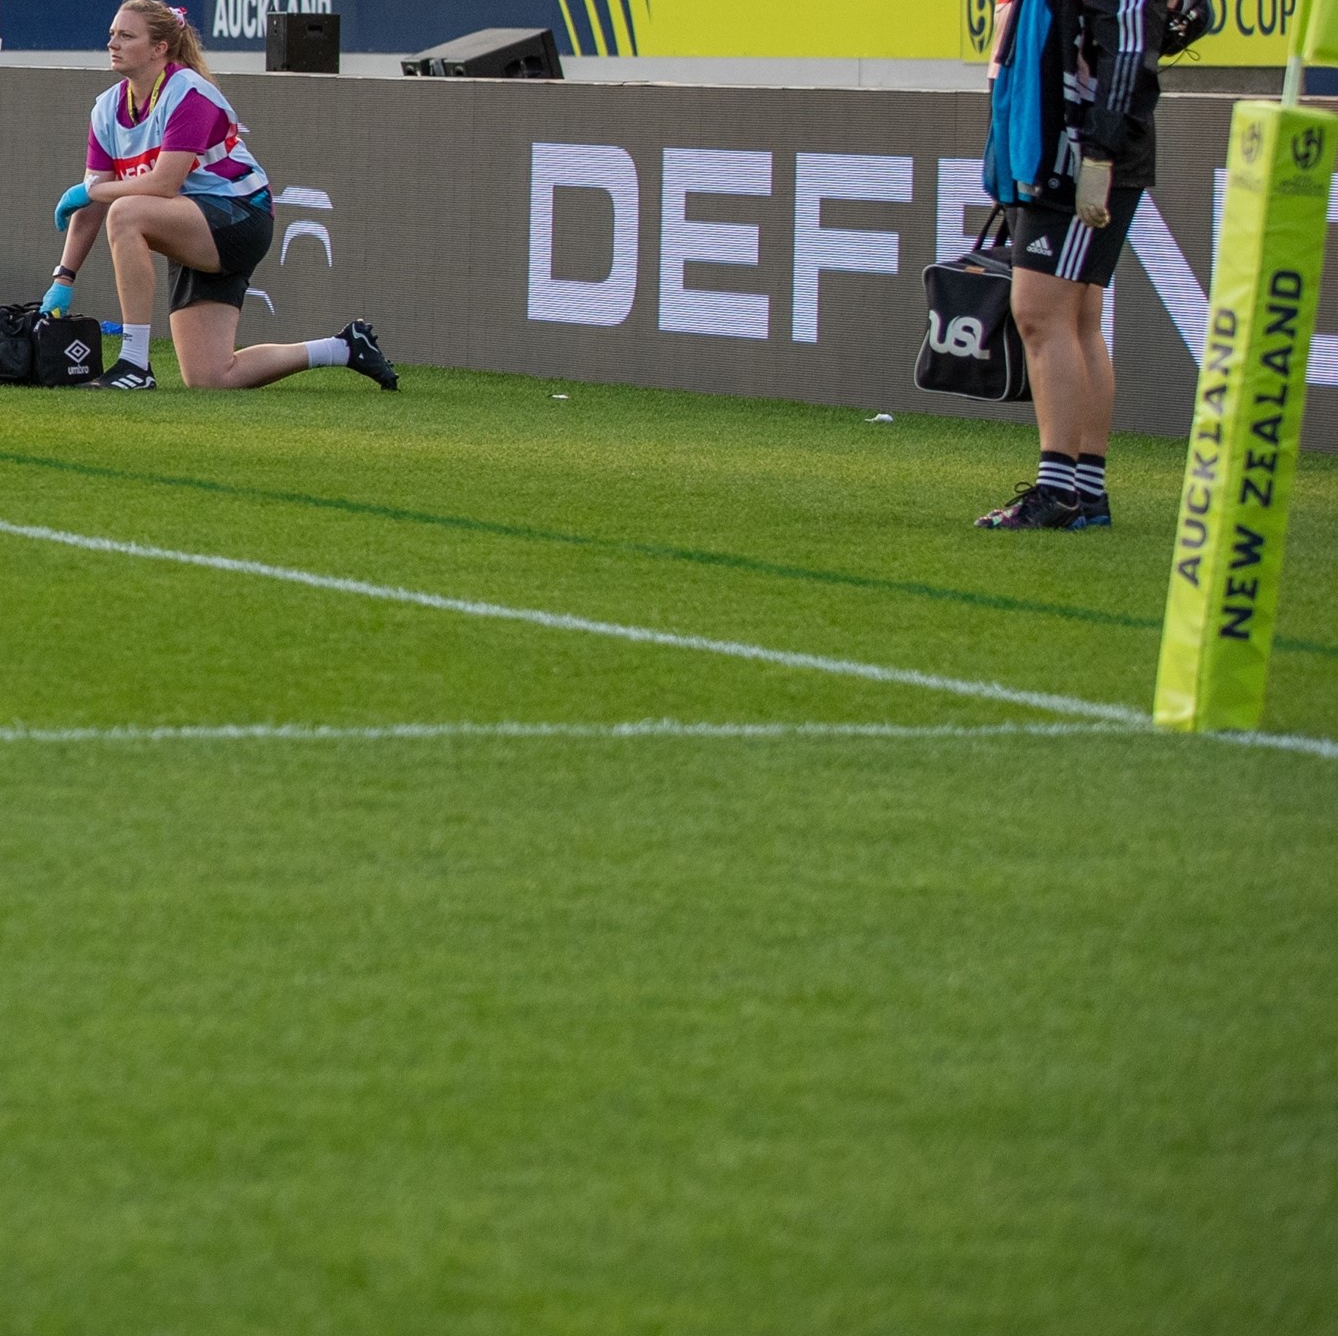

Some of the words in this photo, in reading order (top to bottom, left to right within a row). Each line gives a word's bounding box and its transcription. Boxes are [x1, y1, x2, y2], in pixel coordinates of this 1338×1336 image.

[1026, 245, 1053, 257] adidas
[67, 363, 90, 375] umbro
[1240, 269, 1304, 509] ZEALAND
[1175, 307, 1238, 588] AUCKLAND
[1220, 525, 1264, 640] NEW
